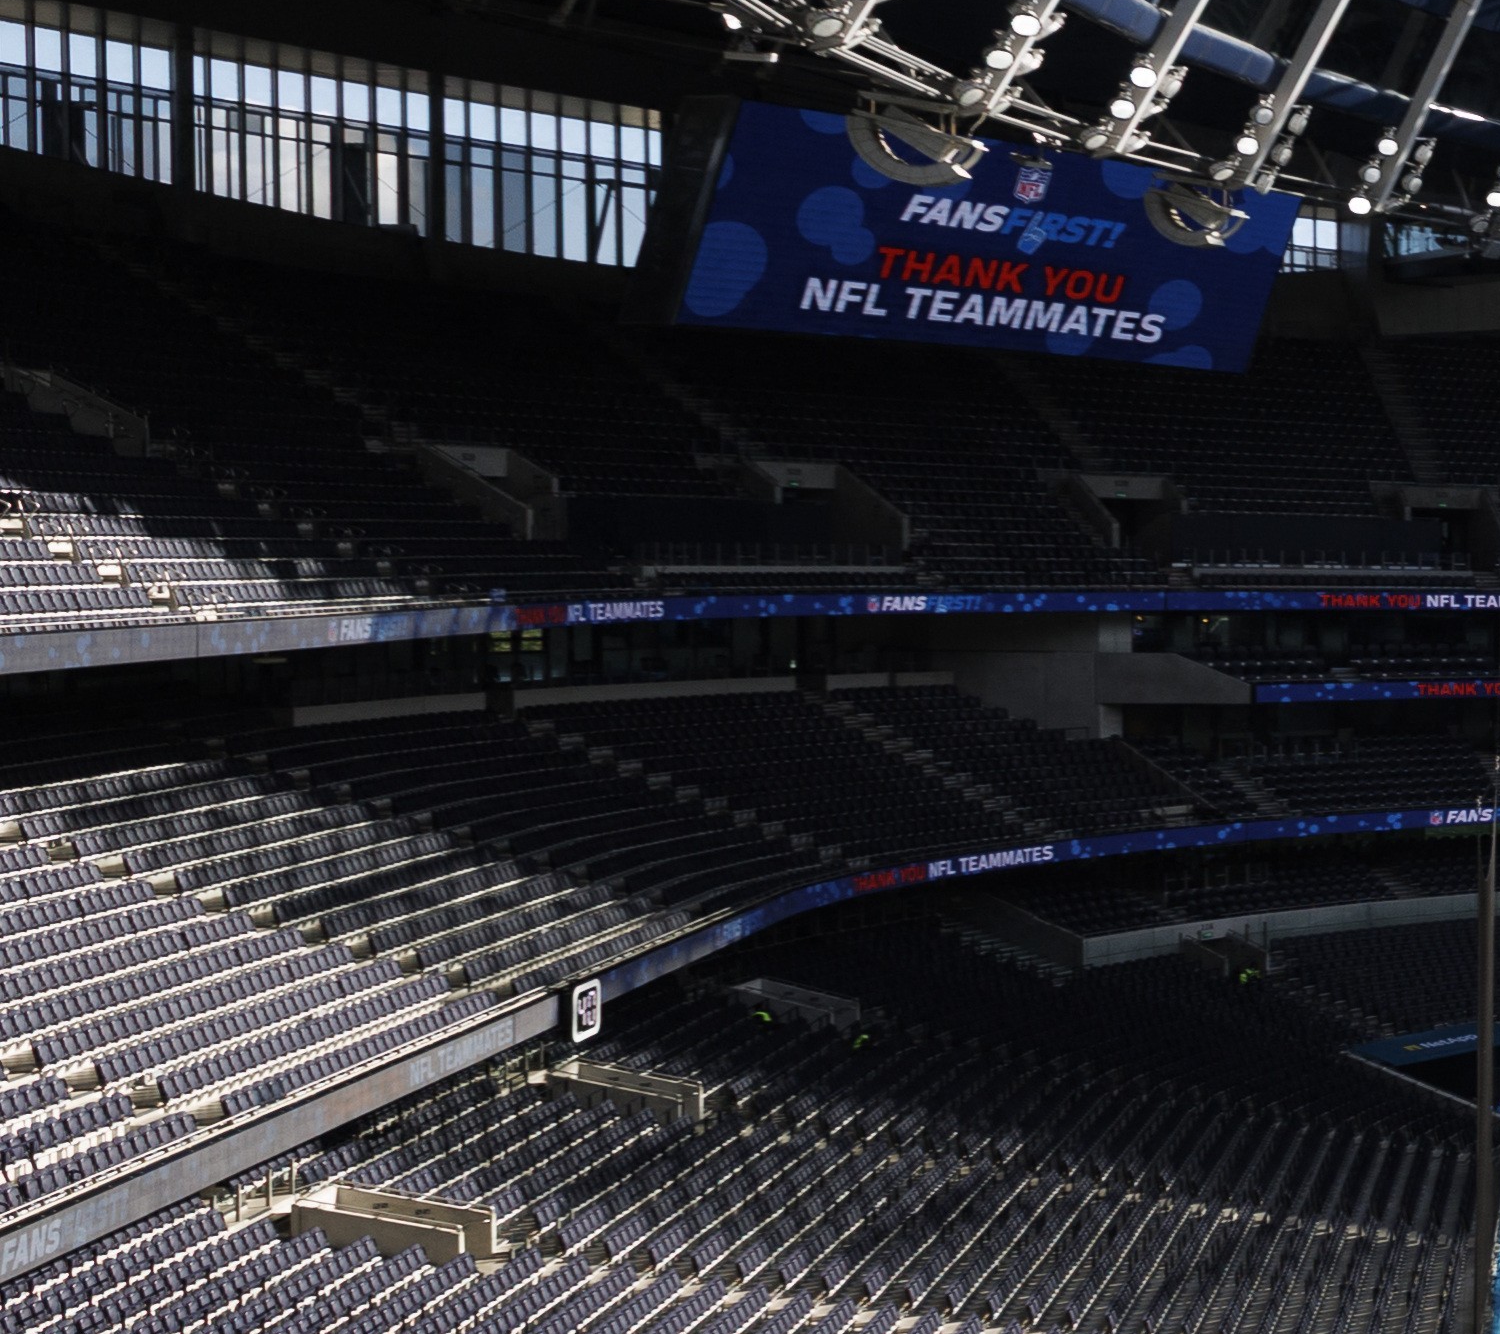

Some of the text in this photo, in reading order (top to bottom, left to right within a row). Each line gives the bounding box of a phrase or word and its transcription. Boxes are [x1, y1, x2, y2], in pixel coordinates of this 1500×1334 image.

[878, 246, 1127, 304] THANK YOU
[800, 277, 1165, 344] NFL TEAMMATES
[1426, 595, 1460, 608] NFL
[928, 857, 956, 879] NFL
[959, 845, 1054, 873] TEAMMATES
